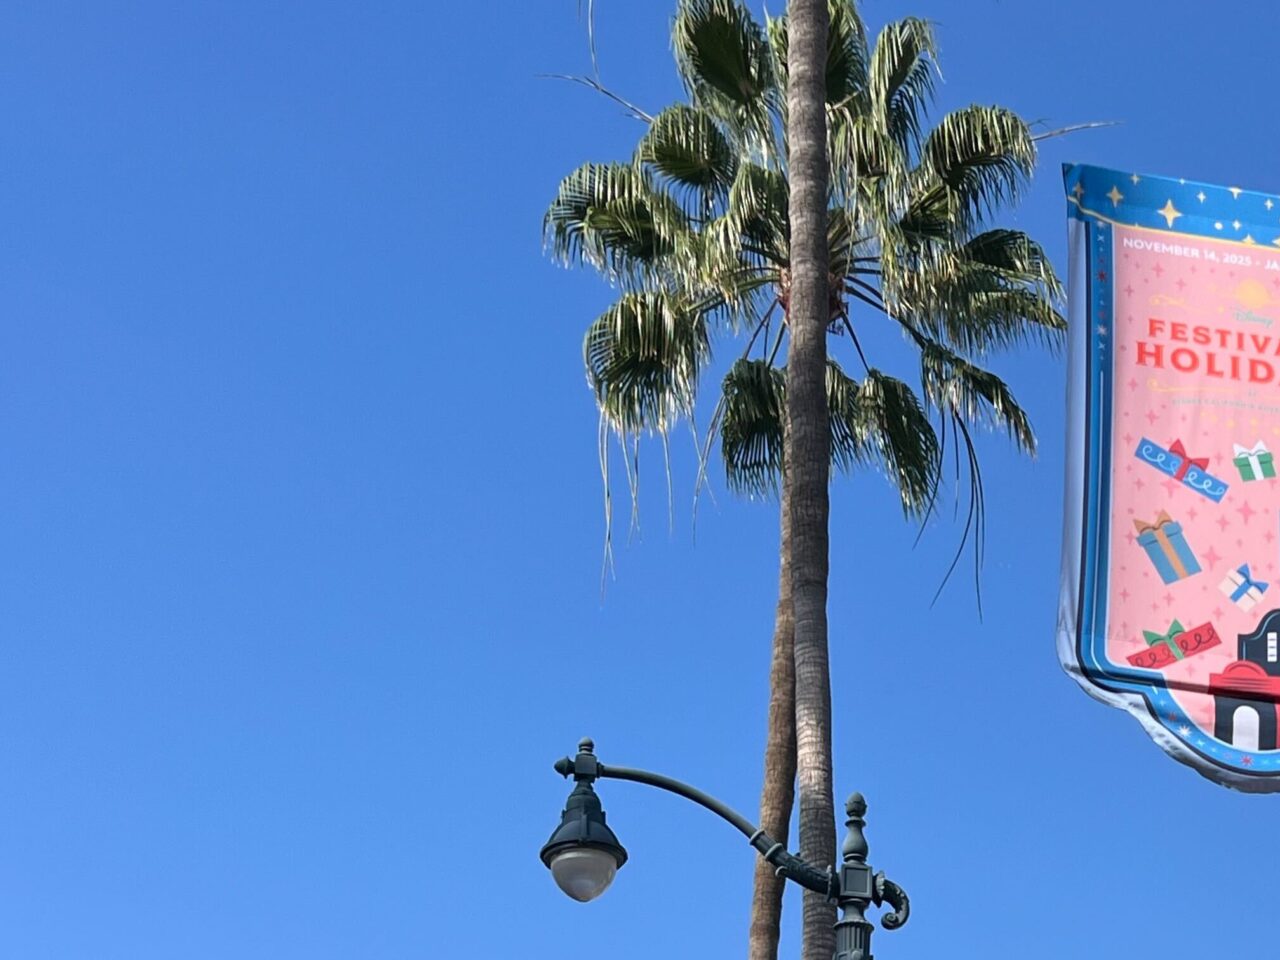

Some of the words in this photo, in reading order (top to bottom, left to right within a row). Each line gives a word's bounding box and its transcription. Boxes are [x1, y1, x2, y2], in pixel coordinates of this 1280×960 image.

[1123, 237, 1200, 258] NOVEMBER
[1223, 252, 1252, 266] 2025
[1234, 310, 1273, 328] Disney
